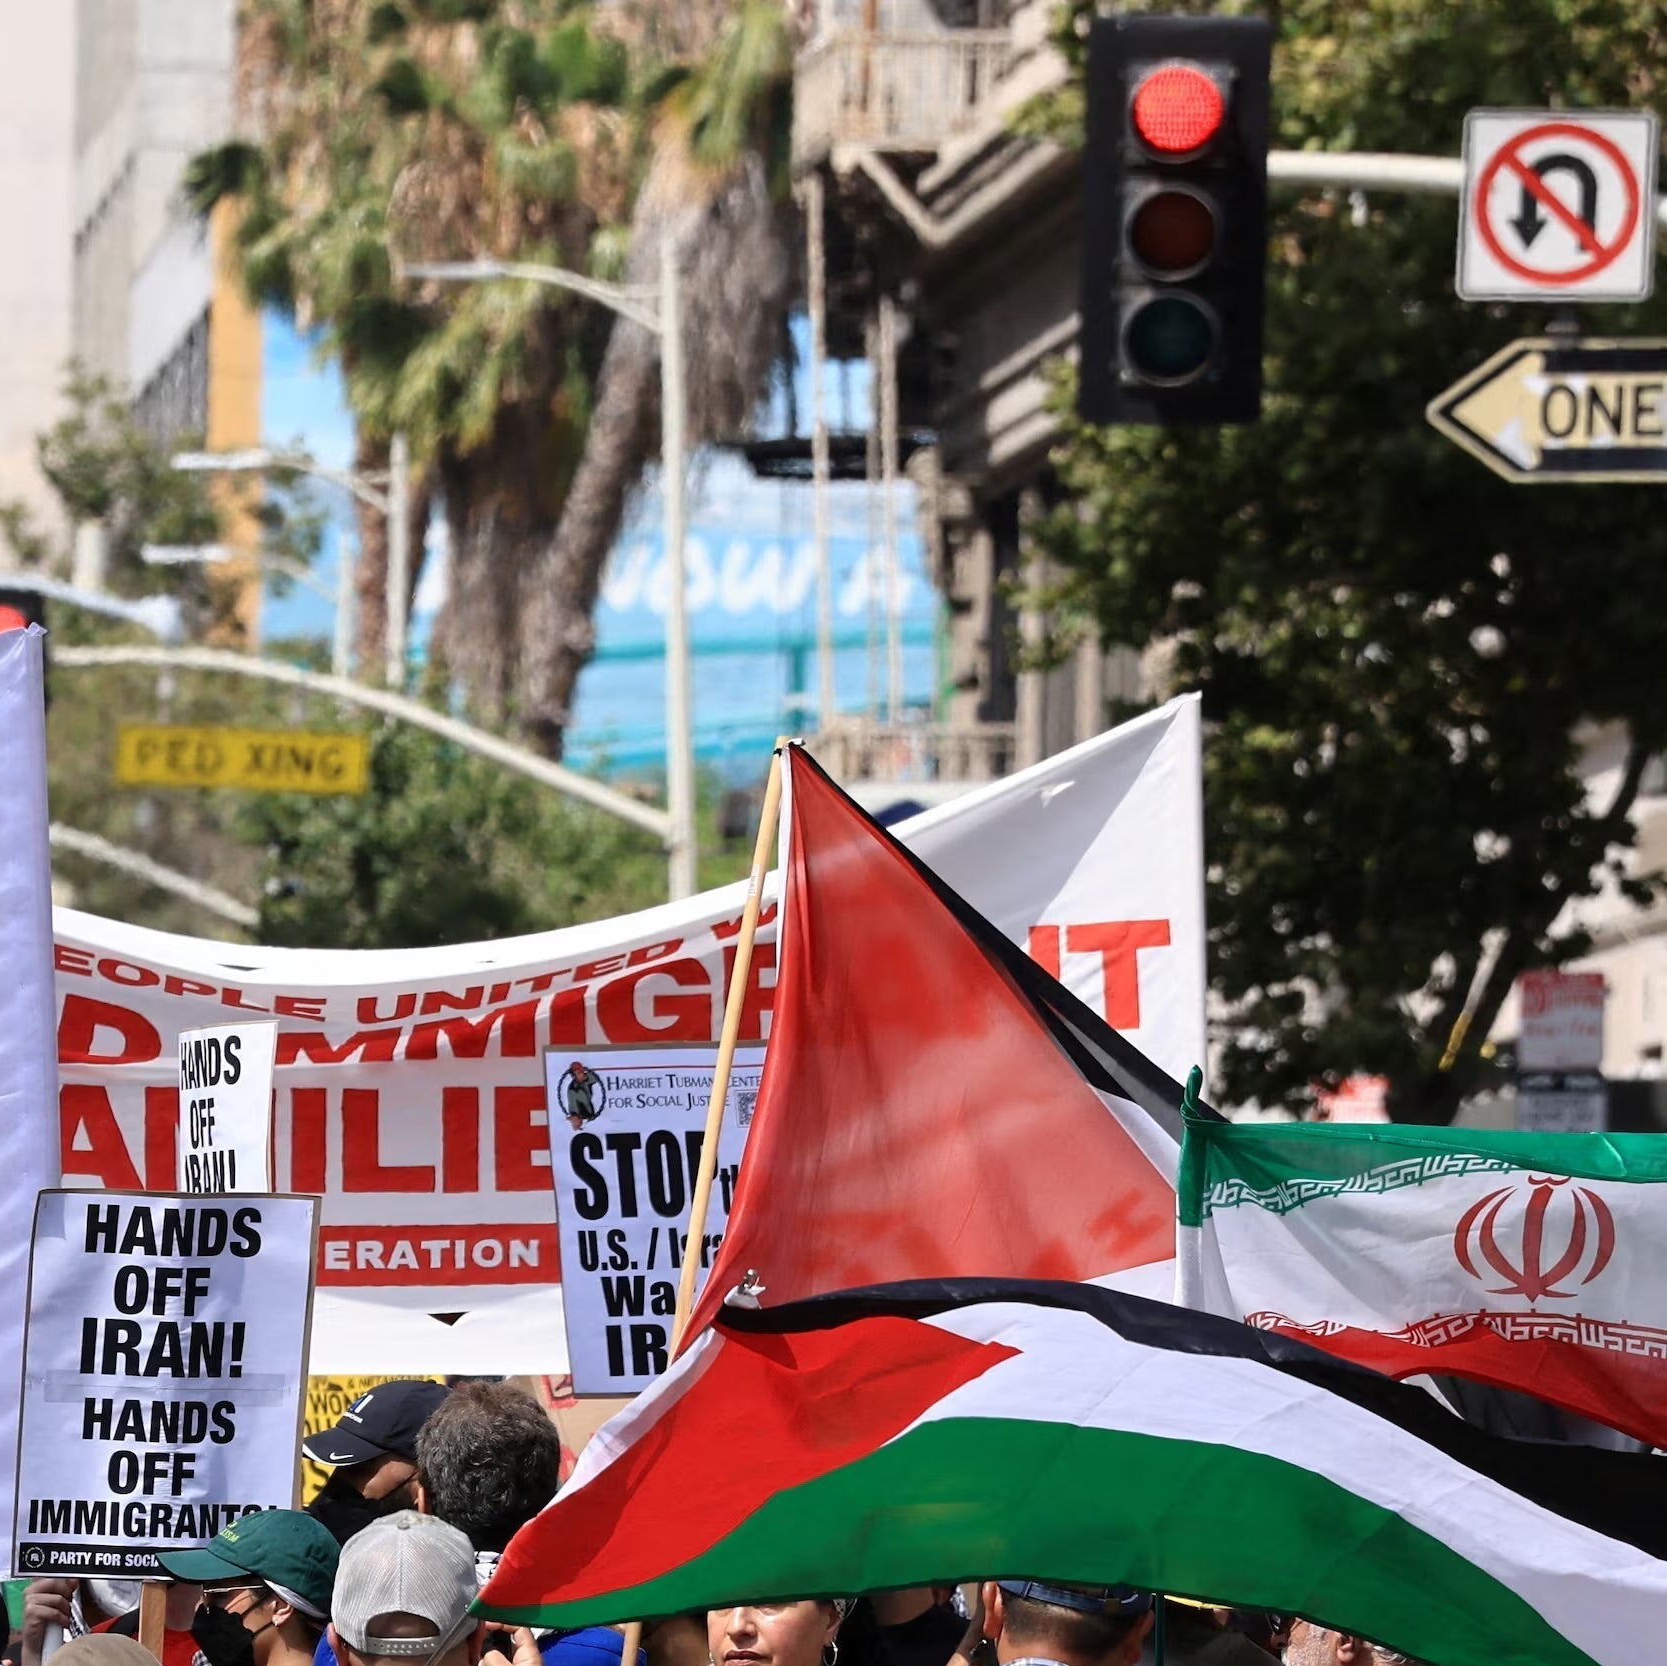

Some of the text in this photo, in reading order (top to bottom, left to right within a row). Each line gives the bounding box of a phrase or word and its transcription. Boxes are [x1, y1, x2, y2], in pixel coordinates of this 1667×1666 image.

[1540, 383, 1665, 439] ONE
[357, 938, 683, 1024] UNITED
[180, 1035, 242, 1090] HANDS
[606, 1075, 662, 1091] HARRIET
[190, 1097, 216, 1150] OFF
[636, 1093, 684, 1109] SOCIAL
[185, 1149, 236, 1194] IRAN!
[85, 1203, 262, 1259] HANDS
[578, 1229, 638, 1272] U.S.
[113, 1264, 211, 1317] OFF
[79, 1317, 246, 1379] IRAN!
[82, 1397, 236, 1444] HANDS
[106, 1450, 197, 1497] OFF
[28, 1499, 278, 1539] IMMIGRANT
[50, 1550, 92, 1566] PARTY
[95, 1551, 122, 1567] FOR
